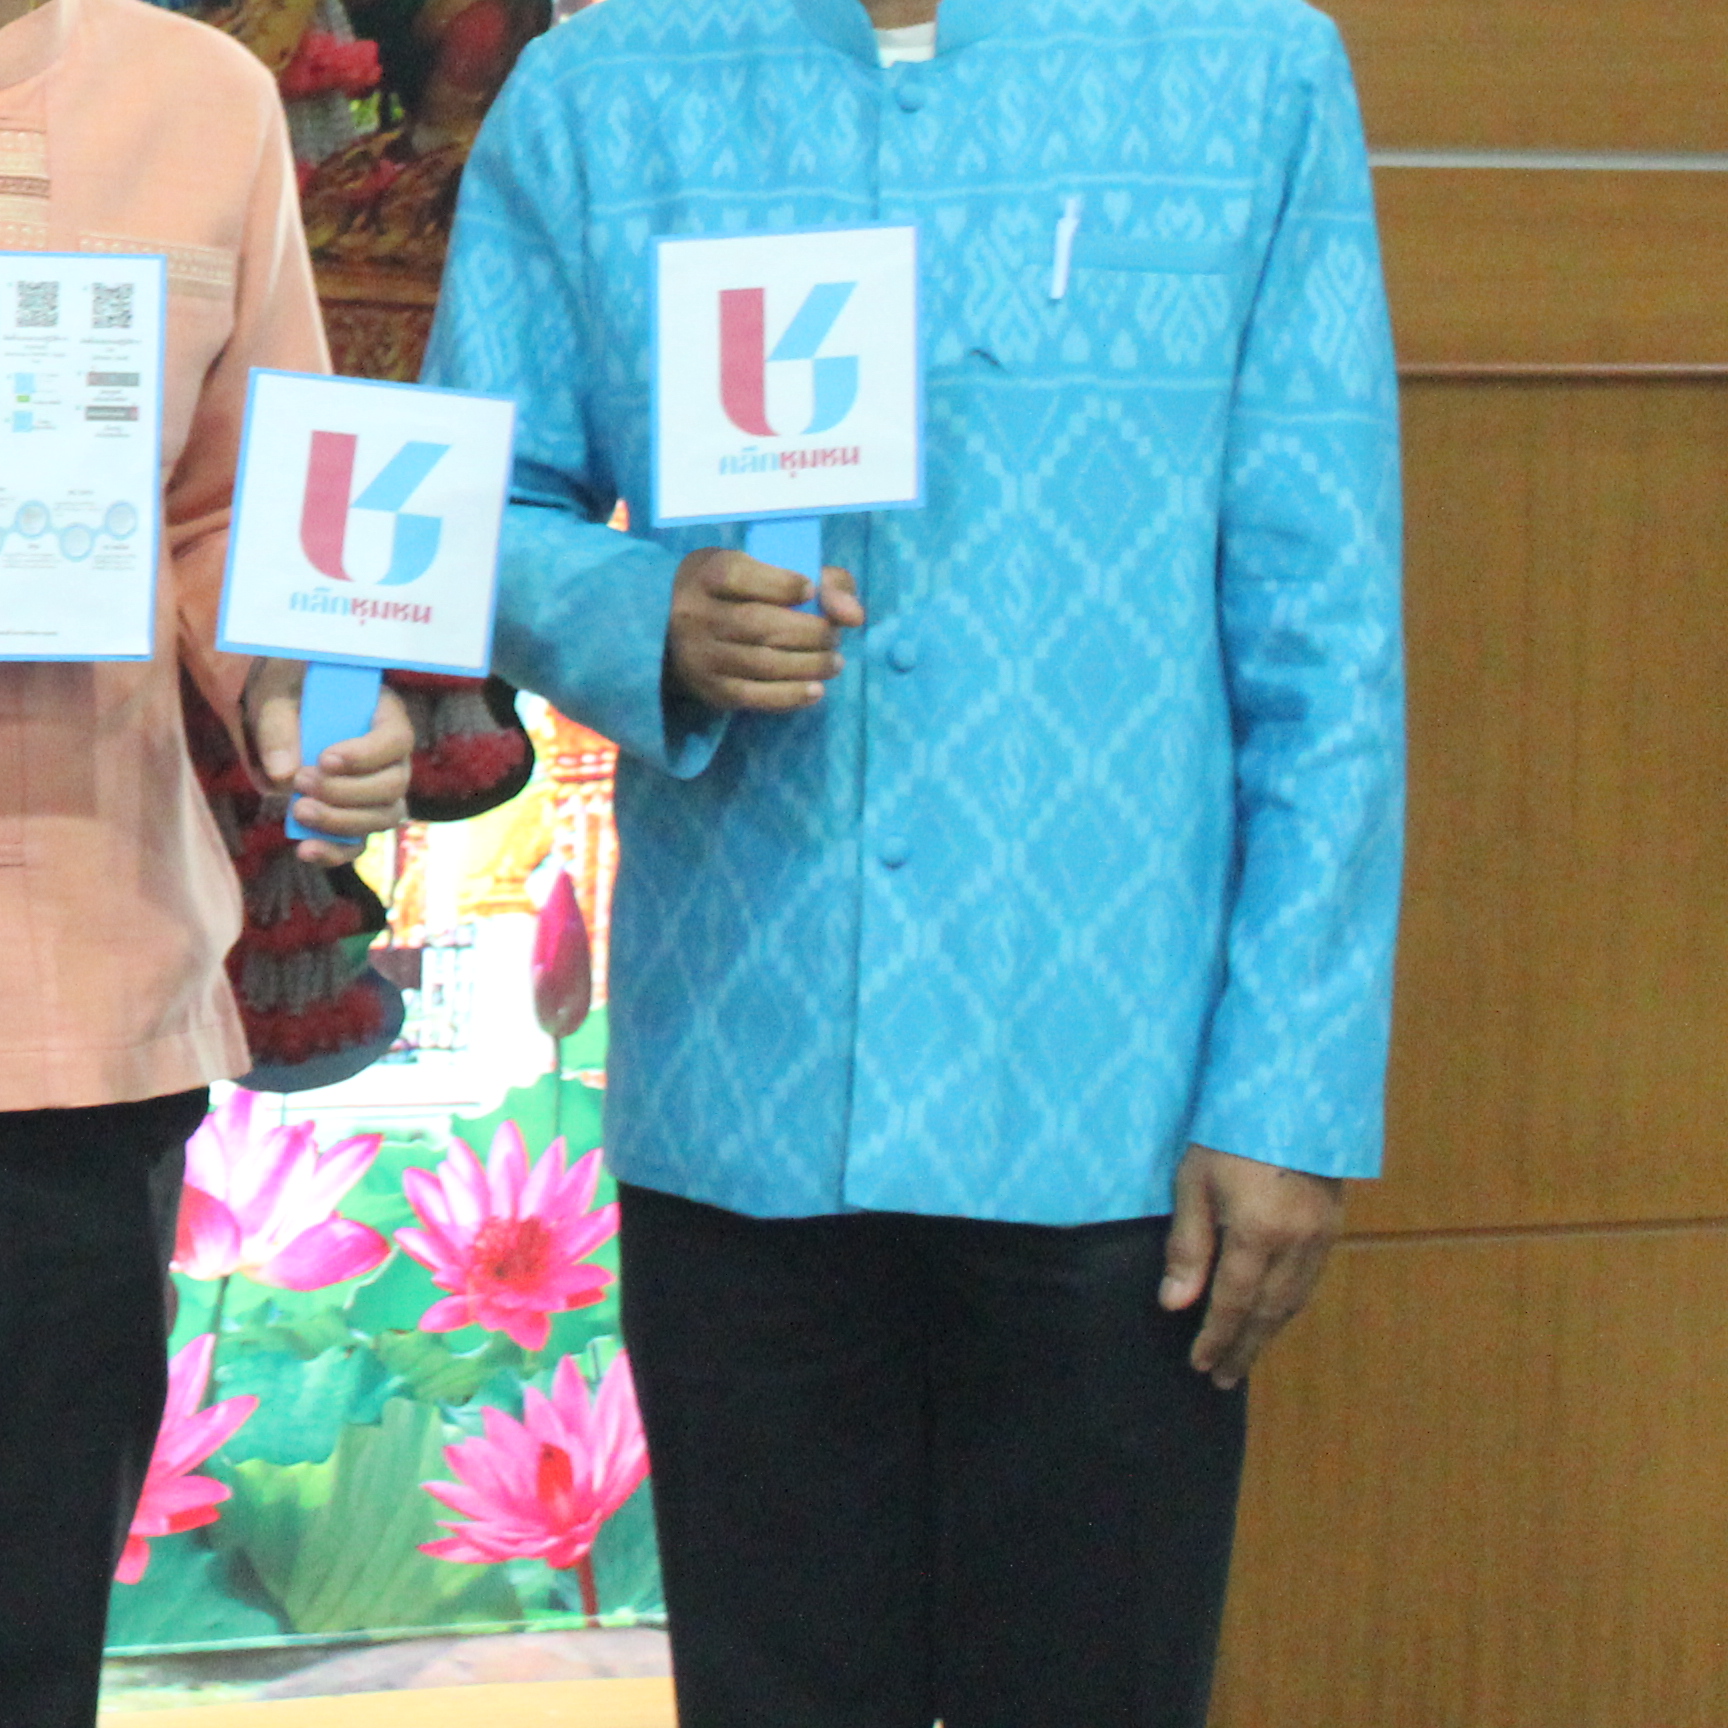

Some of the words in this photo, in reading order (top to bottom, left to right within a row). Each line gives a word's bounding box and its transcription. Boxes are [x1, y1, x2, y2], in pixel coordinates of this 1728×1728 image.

[718, 445, 860, 478] คลิกชุมชน
[289, 587, 432, 627] คลิกชุมชน
